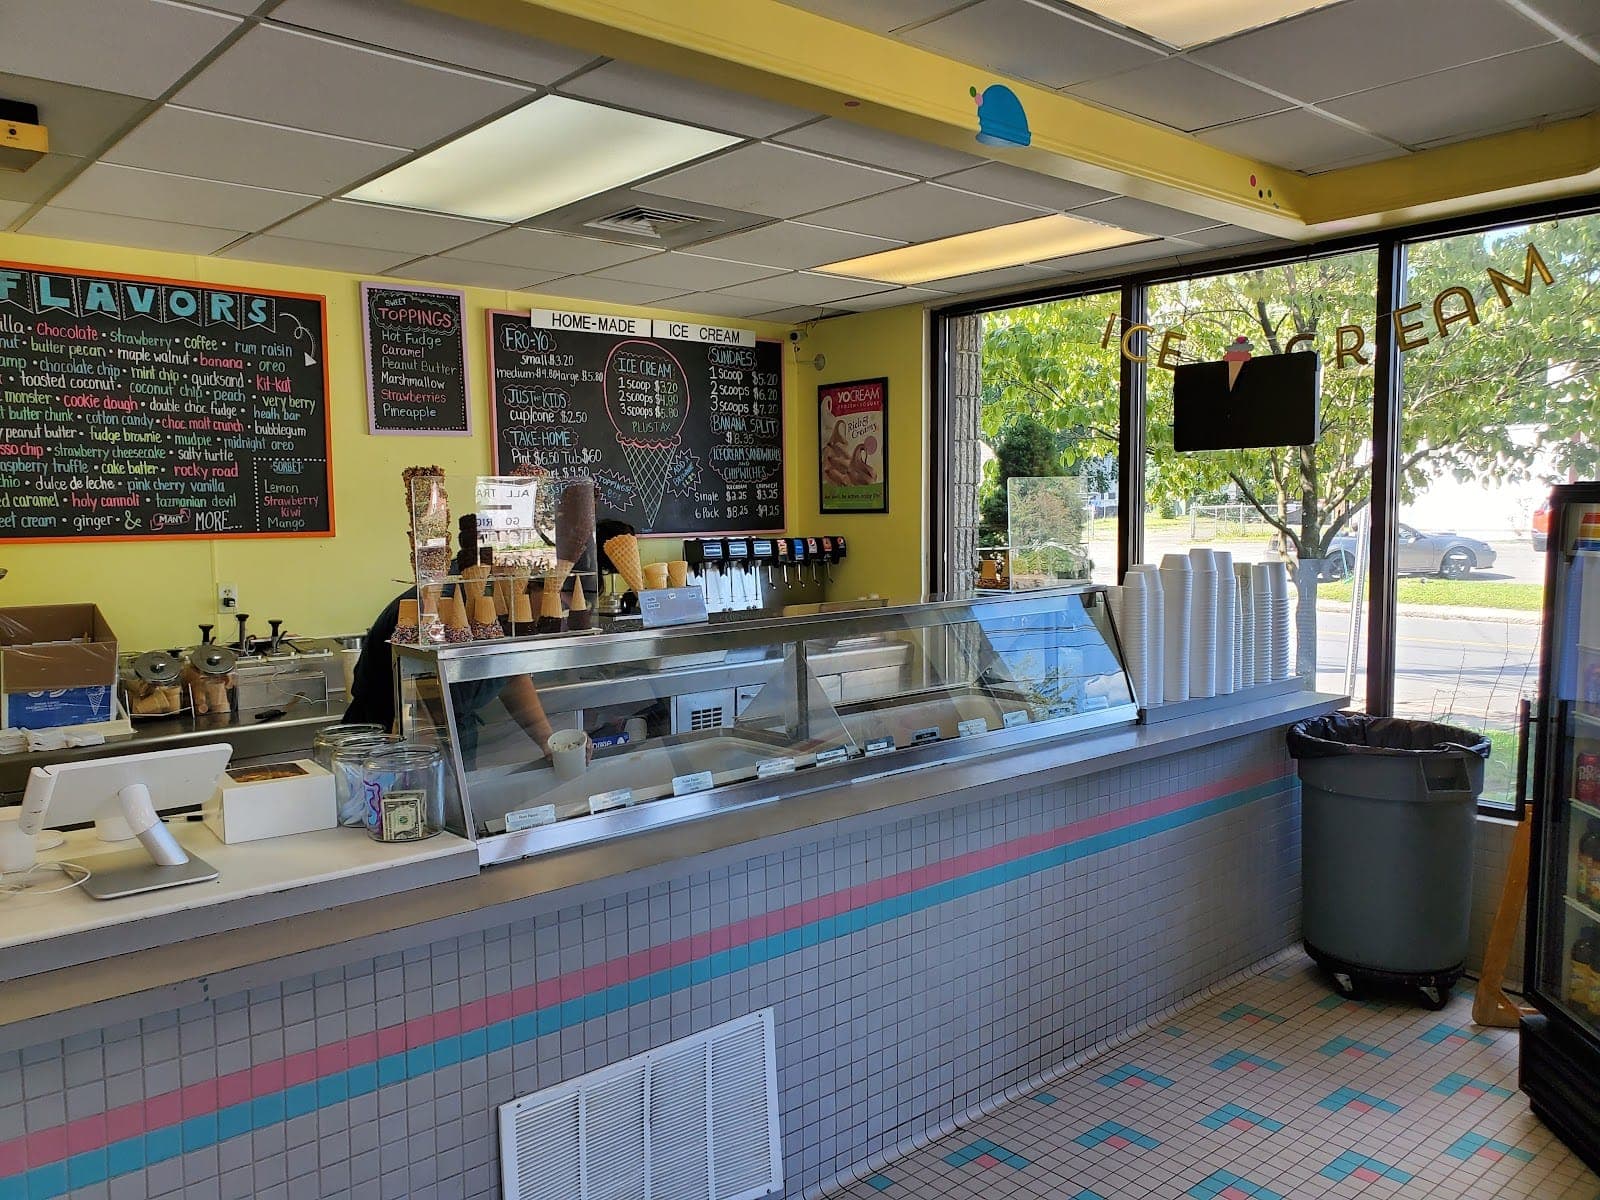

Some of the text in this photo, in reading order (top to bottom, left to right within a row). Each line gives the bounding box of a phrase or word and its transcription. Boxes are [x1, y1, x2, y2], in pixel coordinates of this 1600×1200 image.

[0, 269, 267, 324] FLAVORS
[378, 307, 452, 328] TOPPINGS
[551, 312, 741, 344] HOME-MADE ICE CREAM
[110, 327, 172, 352] strawberry
[184, 335, 218, 351] coffee
[235, 341, 257, 355] rum
[261, 343, 293, 358] raisin
[381, 330, 442, 349] Hot Fudge
[1101, 312, 1187, 371] ICE
[31, 335, 66, 354] butter
[69, 345, 106, 359] pecan
[117, 347, 151, 365] maple
[153, 350, 190, 365] walnut
[200, 351, 244, 370] banana
[259, 360, 286, 373] oreo
[381, 344, 424, 358] Caramel
[40, 356, 94, 375] chocolate
[97, 362, 121, 380] chip
[131, 365, 155, 380] mint
[158, 367, 179, 385] chip
[191, 370, 244, 389] quicksand
[382, 356, 457, 376] Peanut Butter
[617, 357, 672, 379] ICE CREAM
[708, 366, 718, 380] 1
[718, 368, 744, 385] scoop
[381, 371, 446, 390] Marshmallow
[617, 376, 626, 389] 1
[626, 379, 651, 394] scoop
[20, 370, 67, 389] toasted
[70, 376, 115, 391] coconut
[130, 381, 173, 396] coconut
[180, 384, 203, 402] chip
[213, 388, 245, 403] peach
[262, 396, 286, 412] very
[289, 394, 316, 415] berry
[381, 389, 447, 404] Strawberries
[507, 388, 536, 406] JUST
[542, 392, 567, 409] KIDS
[617, 390, 626, 402] 2
[626, 392, 653, 407] scoops
[710, 380, 719, 395] 2
[719, 384, 750, 401] scoops
[837, 386, 880, 404] YOCREAM
[4, 389, 52, 405] monster
[64, 394, 100, 408] cookie
[104, 395, 138, 413] dough
[150, 396, 180, 412] double
[185, 400, 208, 414] choc
[210, 401, 237, 419] fudge
[283, 409, 301, 420] bar
[382, 403, 437, 420] Pineapple
[619, 402, 627, 415] 3
[626, 405, 654, 419] scoops
[710, 394, 719, 411] 3
[719, 400, 750, 416] scoops
[8, 405, 42, 421] butter
[45, 406, 74, 421] chunk
[86, 410, 119, 426] cotton
[121, 412, 154, 430] candy
[162, 414, 187, 430] choc
[189, 416, 212, 430] malt
[213, 418, 244, 432] crunch
[255, 419, 306, 438] bubblegum
[561, 410, 588, 424] $2.50
[712, 414, 747, 432] BANANA
[5, 423, 43, 443] peanut
[44, 424, 78, 439] butter
[90, 425, 121, 444] fudge
[123, 427, 163, 443] brownie
[174, 431, 212, 450] mudpie
[224, 434, 266, 452] midnight
[271, 441, 294, 451] oreo
[20, 442, 235, 462] chip strawberry cheesecake salty turtle
[511, 447, 532, 465] Pint
[533, 449, 560, 466] $6.50
[561, 449, 580, 465] Tub
[52, 457, 89, 473] truffle
[101, 460, 126, 475] cake
[127, 460, 159, 475] batter
[173, 462, 208, 480] rocky
[212, 461, 239, 477] road
[35, 475, 226, 494] dulce de leche pink cherry vanilla
[264, 479, 299, 493] Lemon
[13, 492, 60, 507] caramel
[71, 491, 97, 512] holy
[101, 491, 140, 507] cannoli
[156, 492, 207, 508] tazmanian
[211, 492, 237, 507] devil
[263, 495, 319, 507] Strawberry
[694, 491, 720, 506] Single
[21, 514, 57, 529] cream
[73, 514, 114, 531] ginger
[267, 516, 305, 531] Mango
